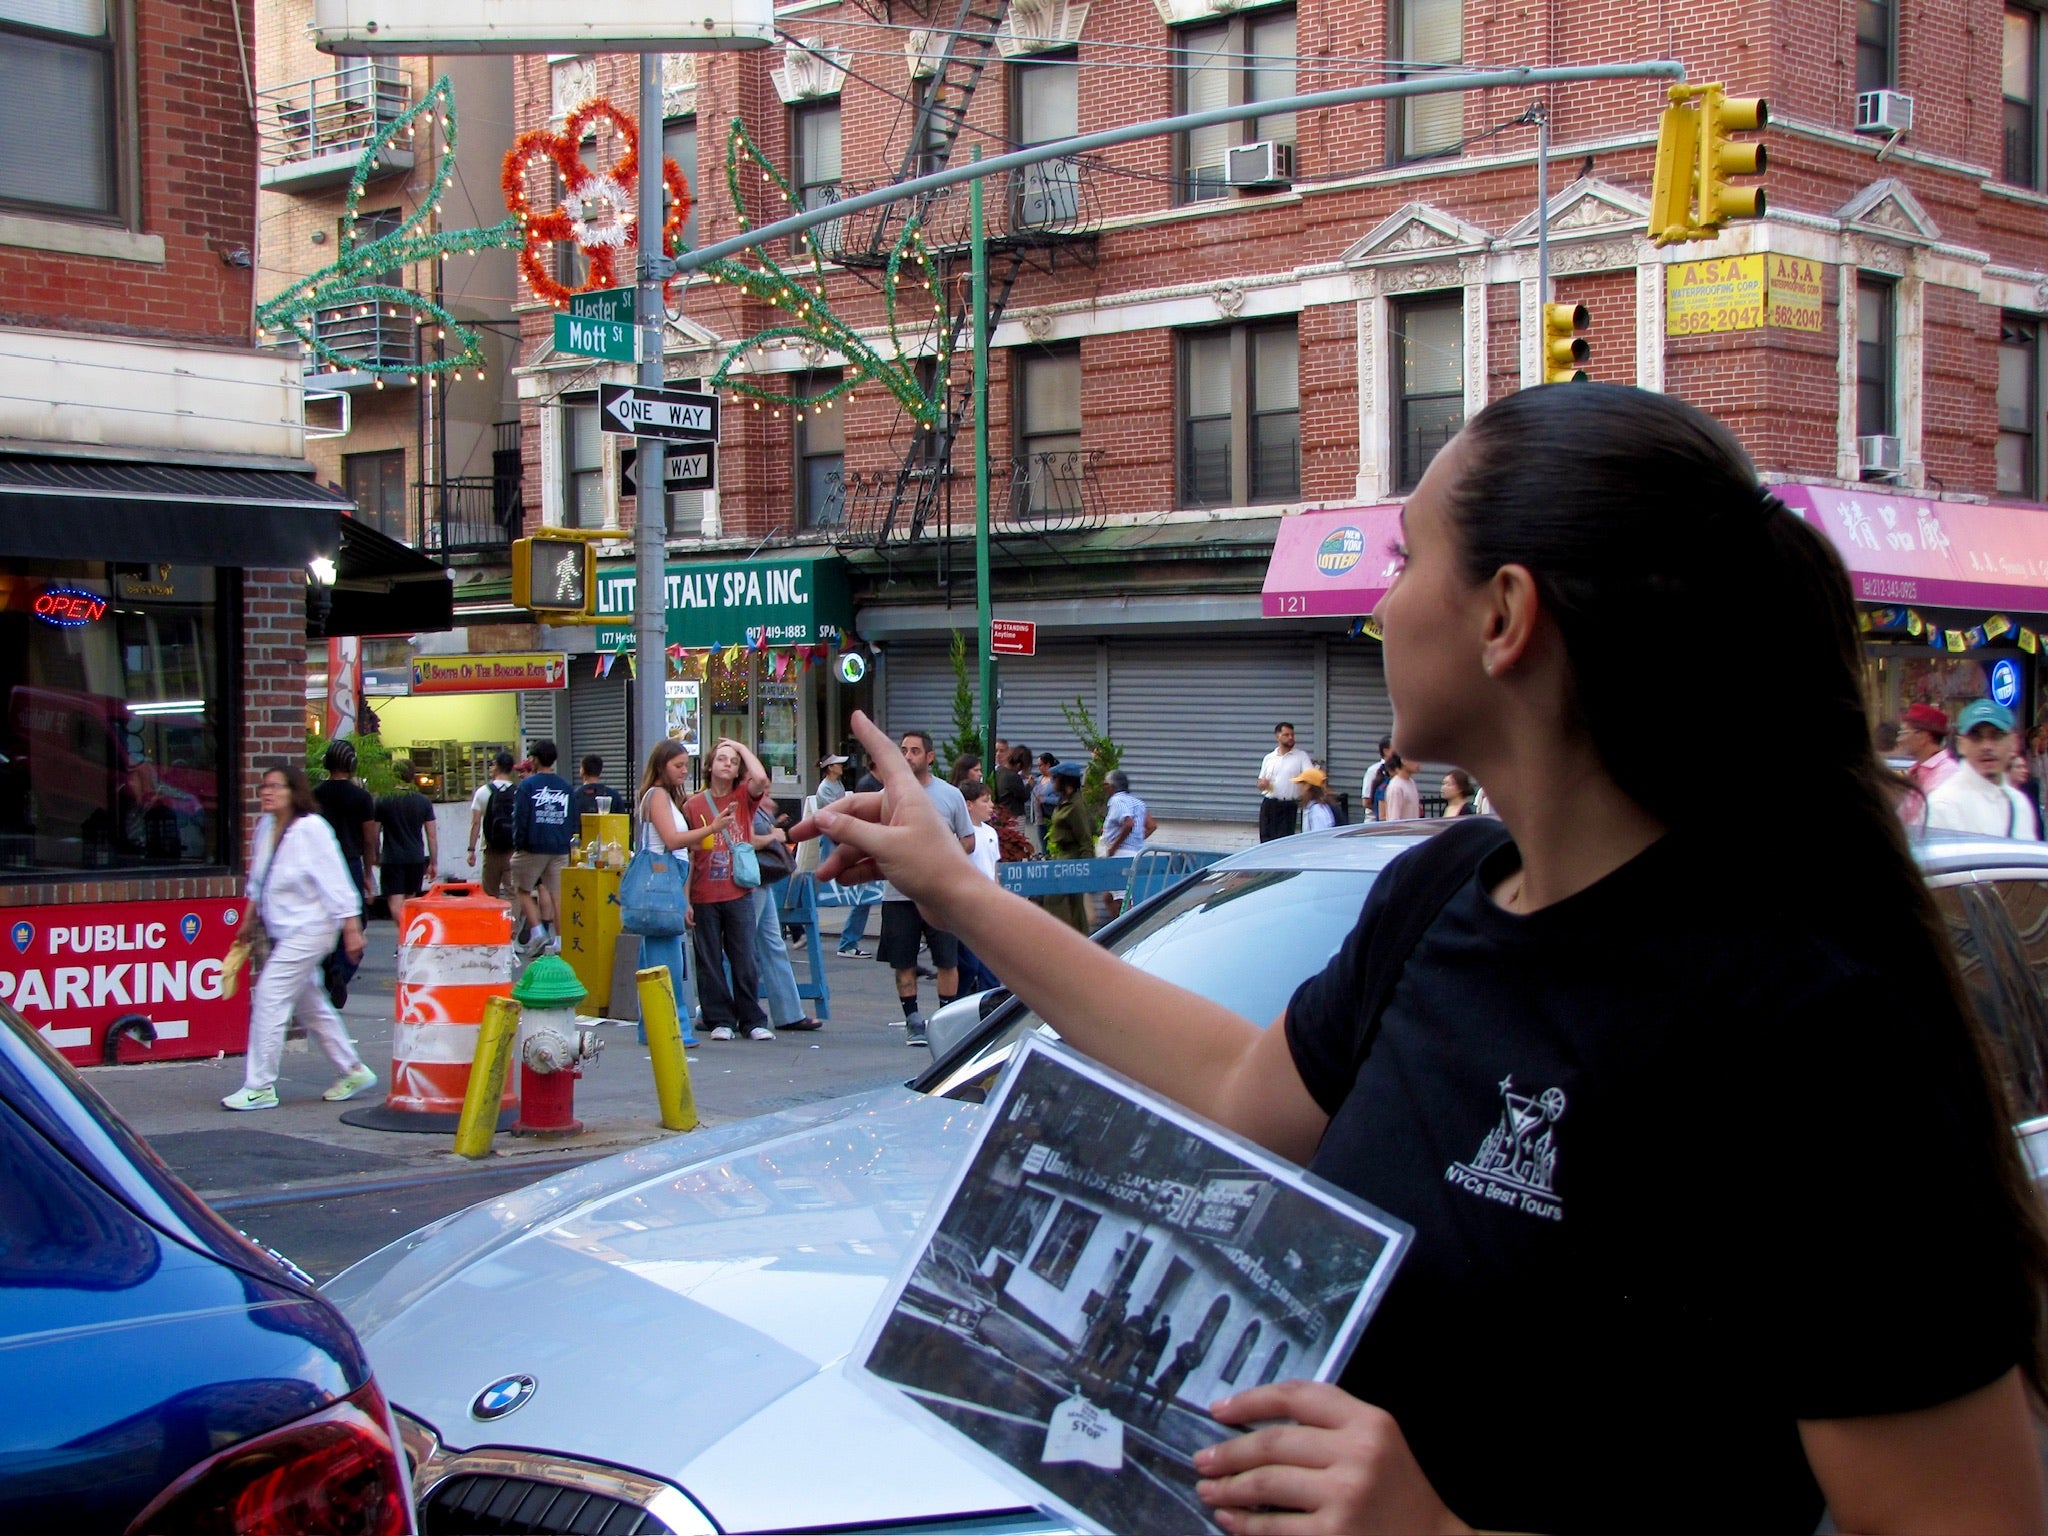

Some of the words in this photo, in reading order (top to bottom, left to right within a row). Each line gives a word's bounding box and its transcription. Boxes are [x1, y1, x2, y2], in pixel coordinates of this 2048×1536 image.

[1683, 262, 1747, 286] A.S.A.
[1671, 283, 1734, 299] WATERPROOFING
[1771, 279, 1806, 293] WATERPROOFING
[575, 298, 617, 321] Hester
[622, 292, 631, 308] St
[1679, 307, 1760, 331] 562-2047
[1775, 305, 1820, 328] 562-2047
[569, 321, 606, 353] Mott
[612, 325, 623, 343] St
[619, 400, 653, 421] ONE
[669, 406, 704, 426] WAY
[671, 458, 701, 477] WAY
[1344, 530, 1360, 539] NEW
[1343, 540, 1361, 552] YORK
[1319, 552, 1361, 569] LOTTERY
[598, 578, 637, 613] LITT
[665, 573, 719, 609] ITALY
[723, 571, 762, 607] SPA
[766, 568, 808, 606] INC.
[35, 595, 106, 621] OPEN
[1278, 596, 1306, 613] 121
[819, 625, 836, 637] SPA
[994, 631, 1016, 639] Anytime
[1003, 624, 1029, 632] STANDING
[601, 633, 614, 645] 177
[615, 632, 637, 644] Heste
[1007, 866, 1022, 879] DO
[1027, 864, 1049, 878] NOT
[1054, 863, 1090, 877] CROSS
[50, 922, 166, 955] PUBLIC
[1444, 1165, 1485, 1195] NYCs
[1485, 1181, 1517, 1206] Best
[1520, 1192, 1563, 1221] Tours
[1072, 1420, 1101, 1439] STOP
